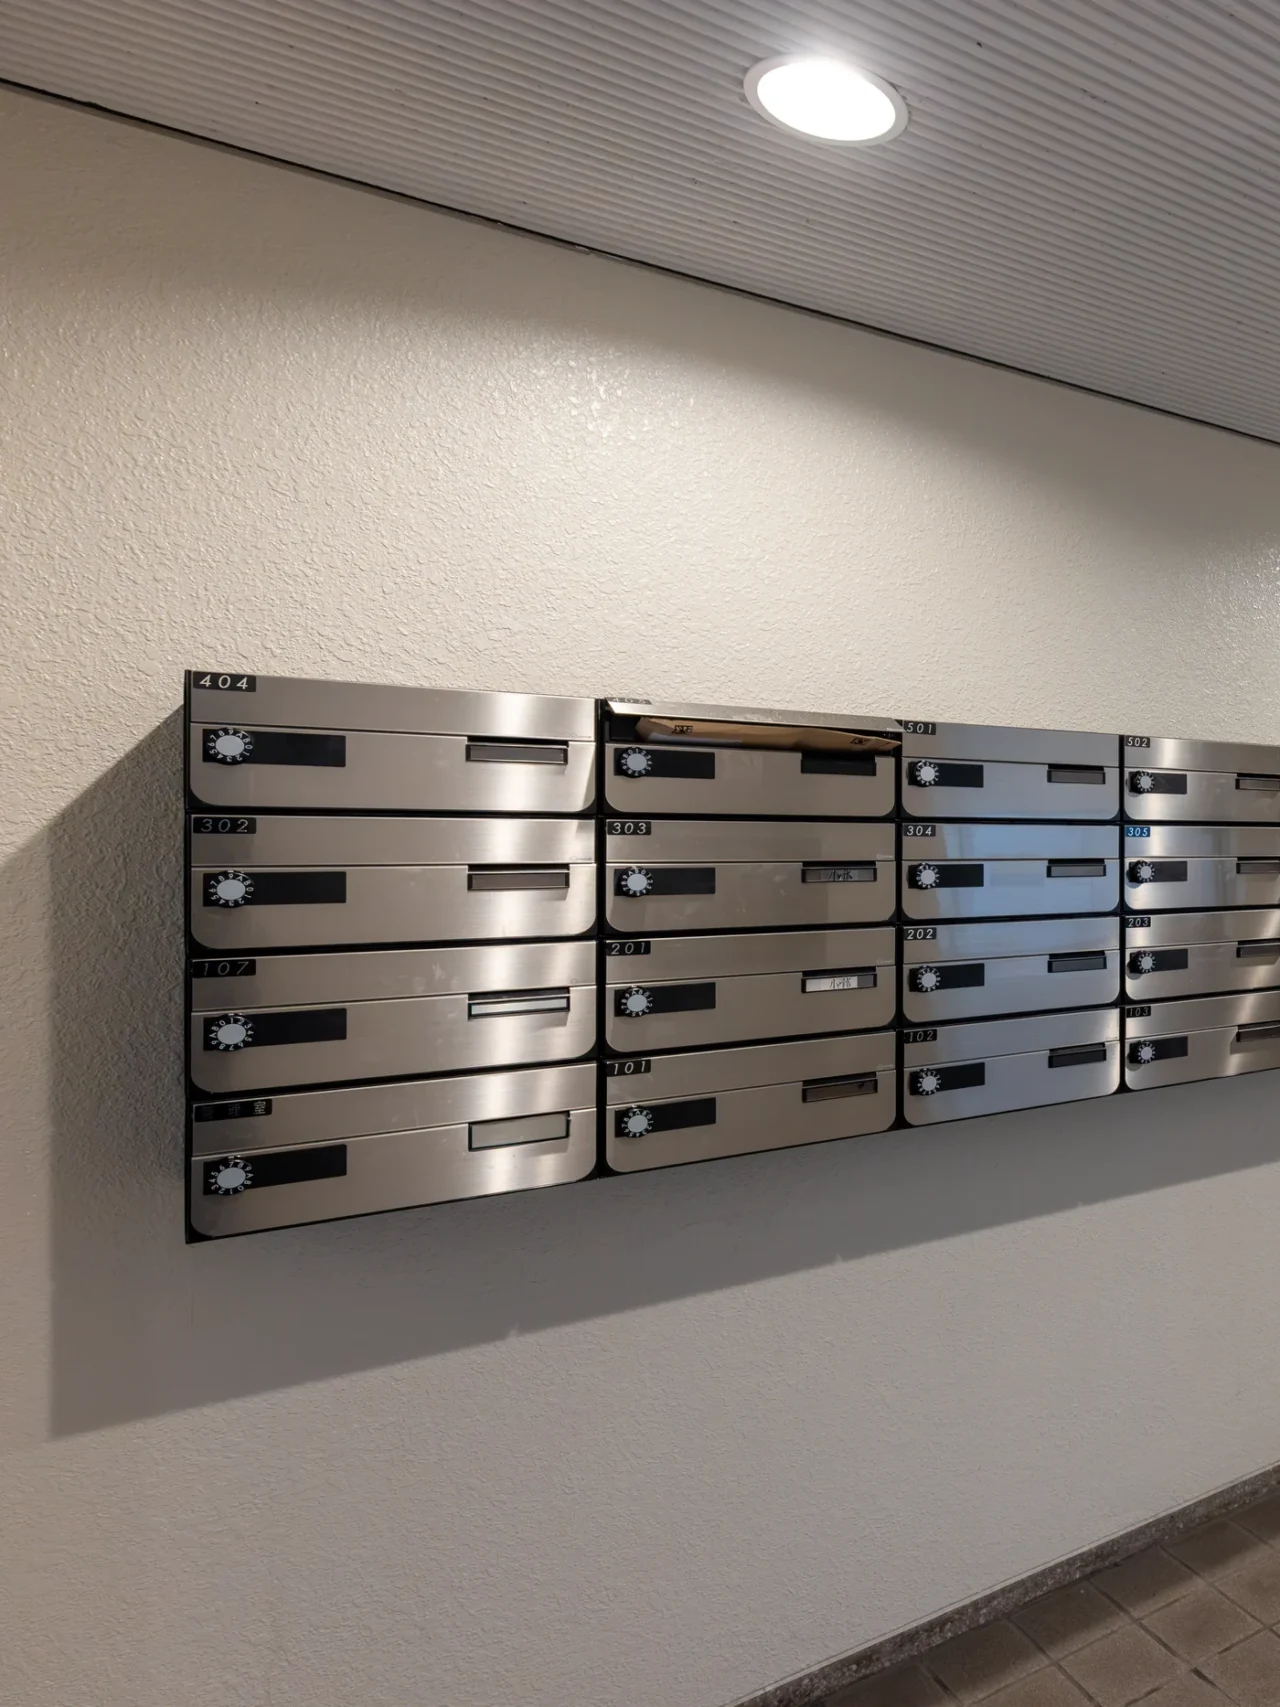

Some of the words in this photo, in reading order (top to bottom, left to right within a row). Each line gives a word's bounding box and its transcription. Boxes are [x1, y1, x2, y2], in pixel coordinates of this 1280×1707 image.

[199, 674, 249, 689] 404
[906, 722, 932, 734] 501
[1127, 738, 1147, 747] 502
[200, 819, 249, 833] 302
[612, 823, 647, 834] 303
[906, 826, 932, 836] 304
[1128, 828, 1148, 836] 305
[1128, 918, 1148, 927] 203
[907, 929, 933, 939] 202
[611, 942, 646, 955] 201
[202, 961, 250, 977] 107
[1129, 1008, 1148, 1016] 103
[908, 1030, 933, 1042] 102
[613, 1061, 646, 1075] 101
